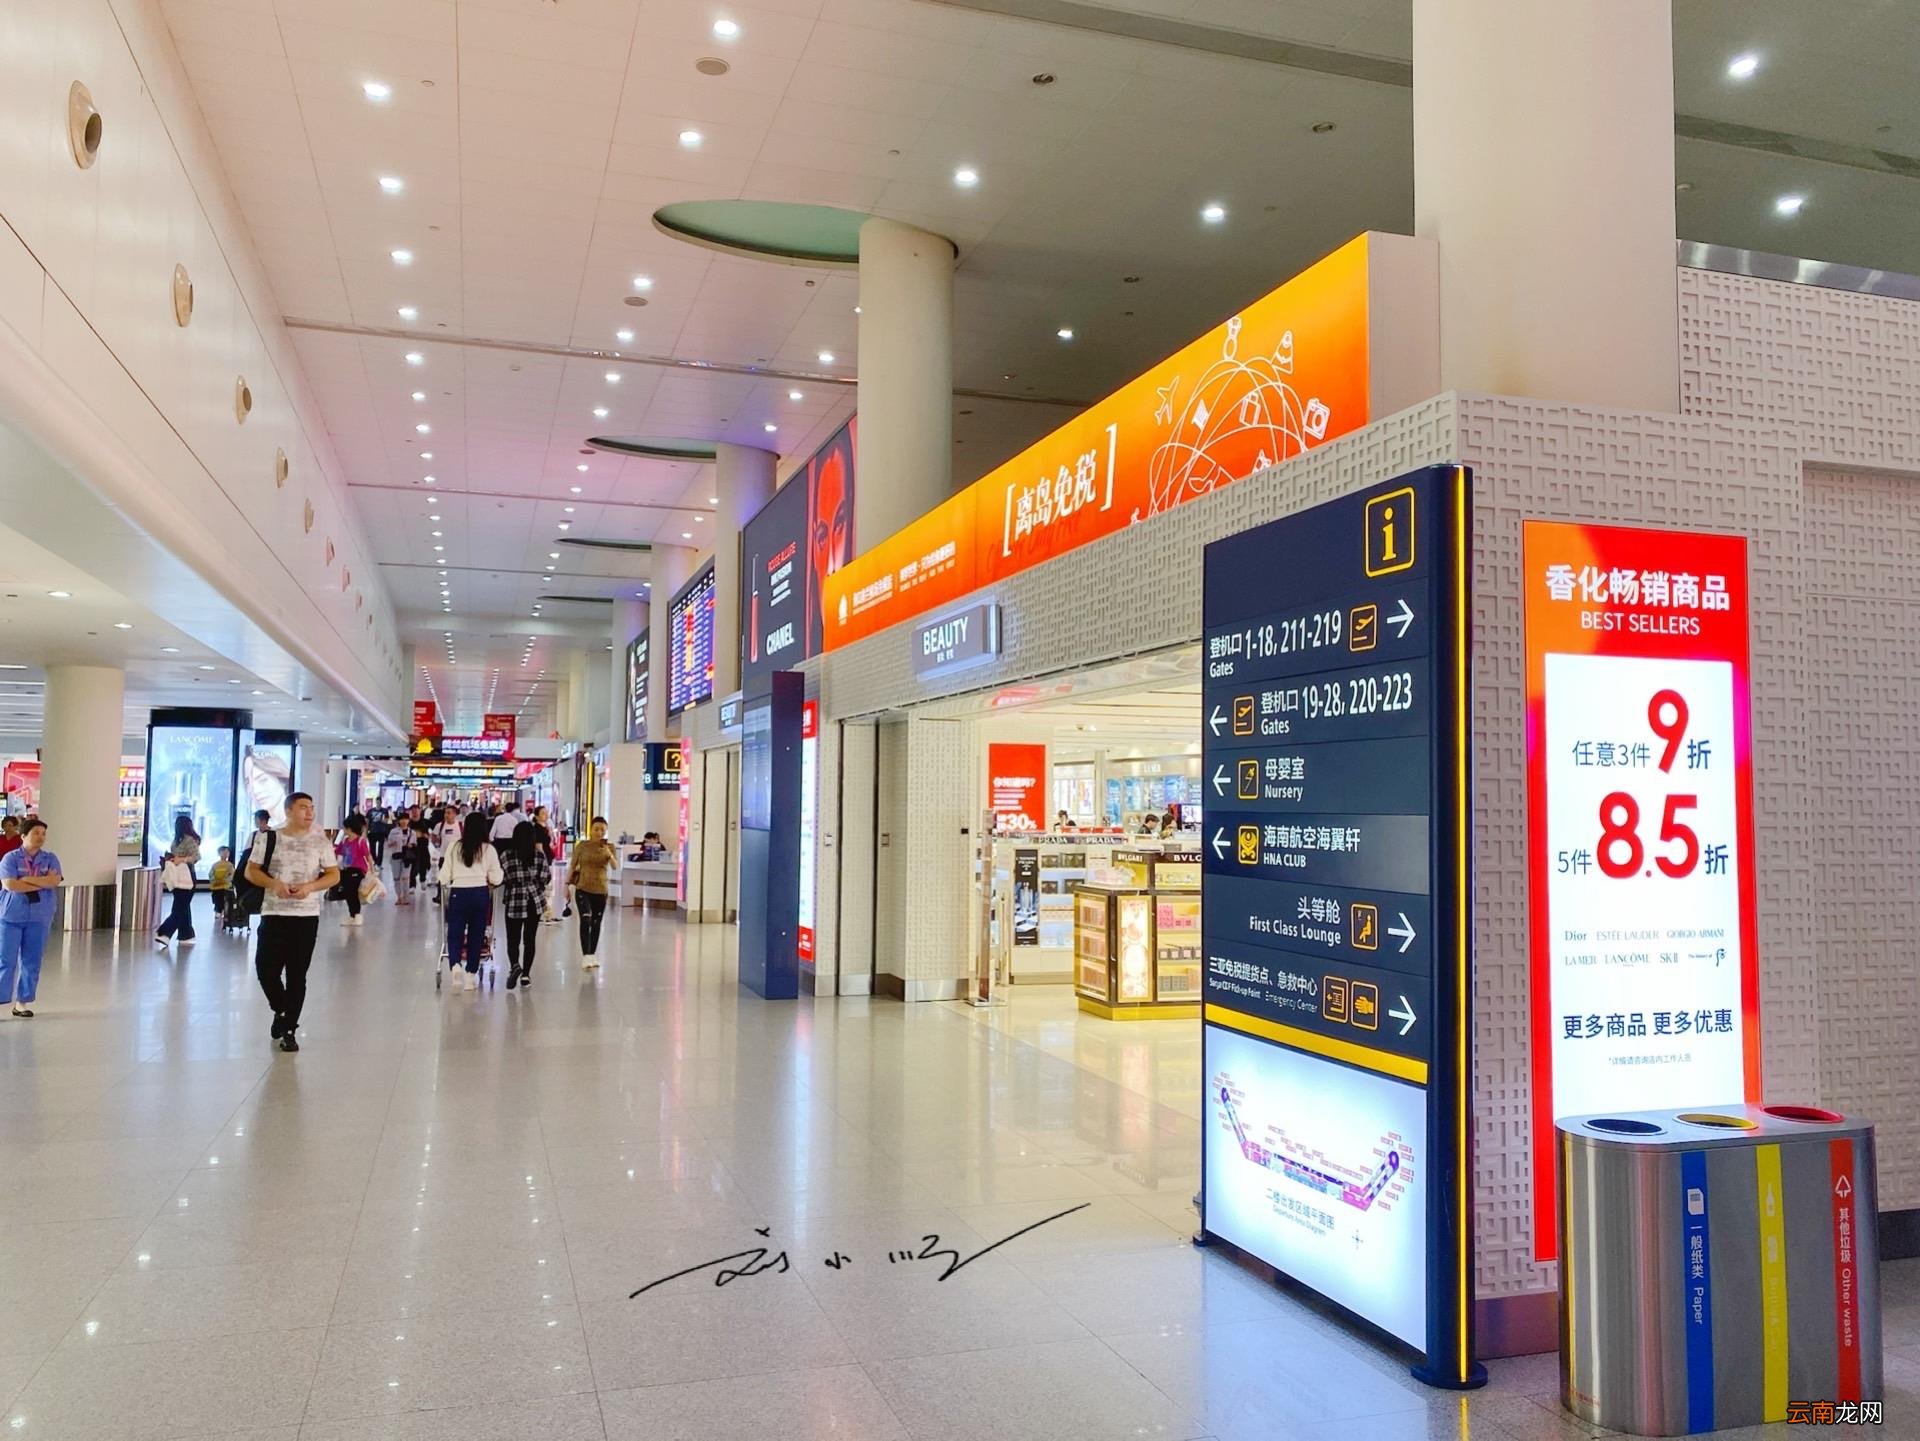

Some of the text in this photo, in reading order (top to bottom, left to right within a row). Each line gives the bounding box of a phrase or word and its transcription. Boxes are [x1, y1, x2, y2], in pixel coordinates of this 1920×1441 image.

[1545, 564, 1730, 611] 香化畅销商品
[923, 616, 968, 655] BEAUTY
[1210, 633, 1242, 659] 登机口
[1281, 610, 1342, 653] 211-219
[1580, 611, 1700, 635] BEST SELLERS
[767, 622, 795, 655] CHANEL
[1209, 662, 1234, 678] Gates
[1261, 672, 1412, 719] 登机口 19-28, 220-223
[1261, 718, 1290, 735] Gates
[1265, 757, 1305, 781] 母婴室
[1264, 785, 1304, 802] Nursery
[1087, 837, 1115, 845] PRADA
[1263, 825, 1361, 853] 海南航空海翼轩
[1263, 853, 1306, 868] HNA CLUB
[1297, 896, 1341, 925] 头等舱
[1249, 916, 1341, 947] First Class Lounge
[1565, 931, 1588, 942] Dior
[1265, 990, 1297, 1010] Emergency
[1563, 1009, 1733, 1039] 更多商品 更多优惠
[1690, 1226, 1704, 1325] 一般纸类 Paper
[1839, 1207, 1853, 1347] 其他垃圾 Other waste
